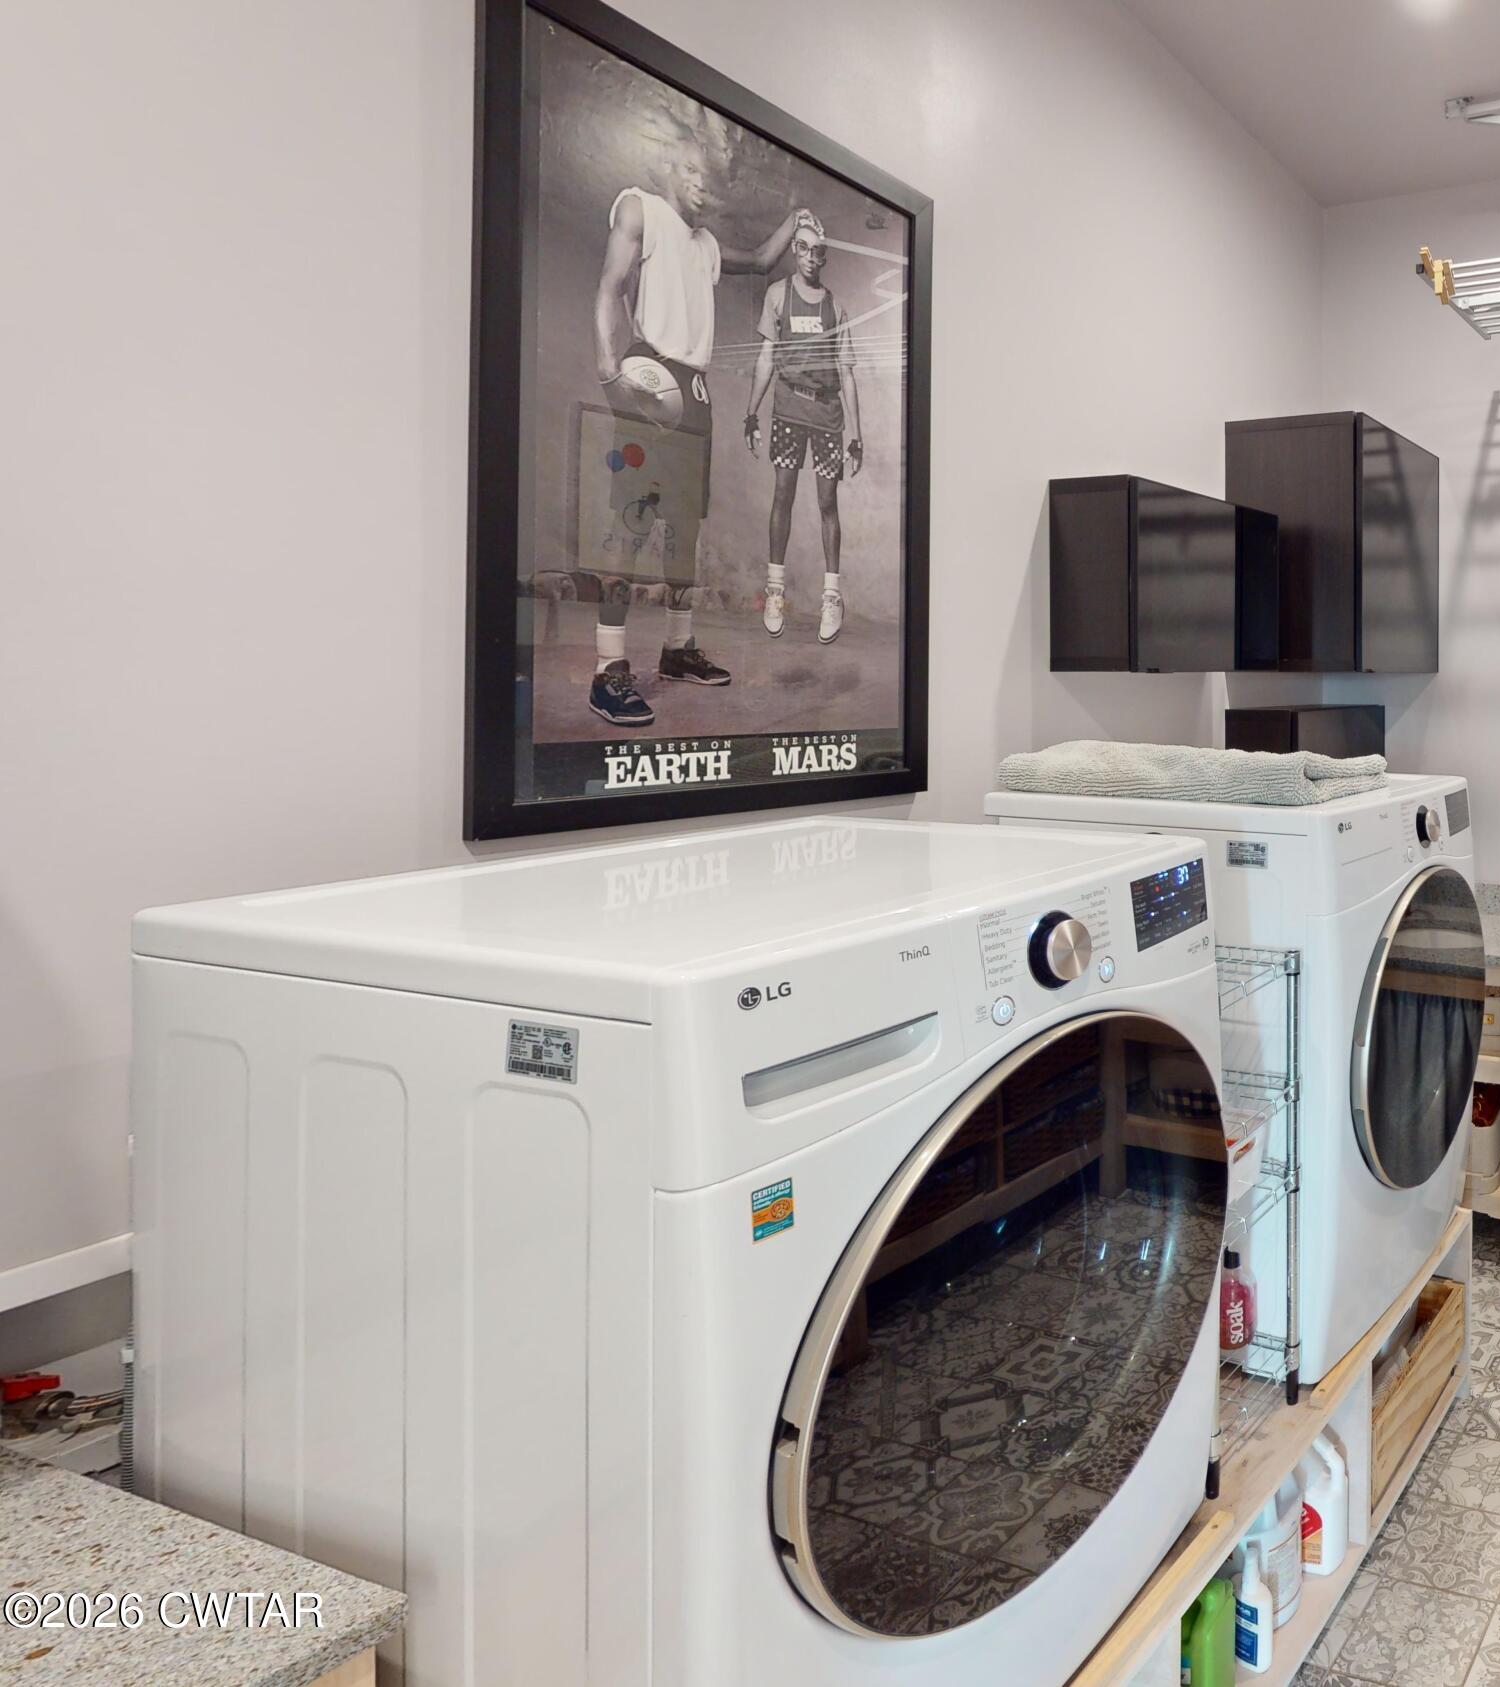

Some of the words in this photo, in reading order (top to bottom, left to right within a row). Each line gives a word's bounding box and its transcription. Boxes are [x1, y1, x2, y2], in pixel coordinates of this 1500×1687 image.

[605, 745, 641, 755] THE
[655, 742, 699, 752] BEST
[711, 740, 731, 749] ON
[773, 737, 798, 746] THE
[805, 735, 836, 744] BEST
[842, 734, 857, 743] ON
[604, 750, 731, 789] EARTH
[772, 743, 857, 776] MARS
[899, 945, 931, 962] ThinQ
[766, 982, 792, 1002] LG
[753, 1180, 791, 1201] CERTIFIED
[1226, 1300, 1244, 1344] soak
